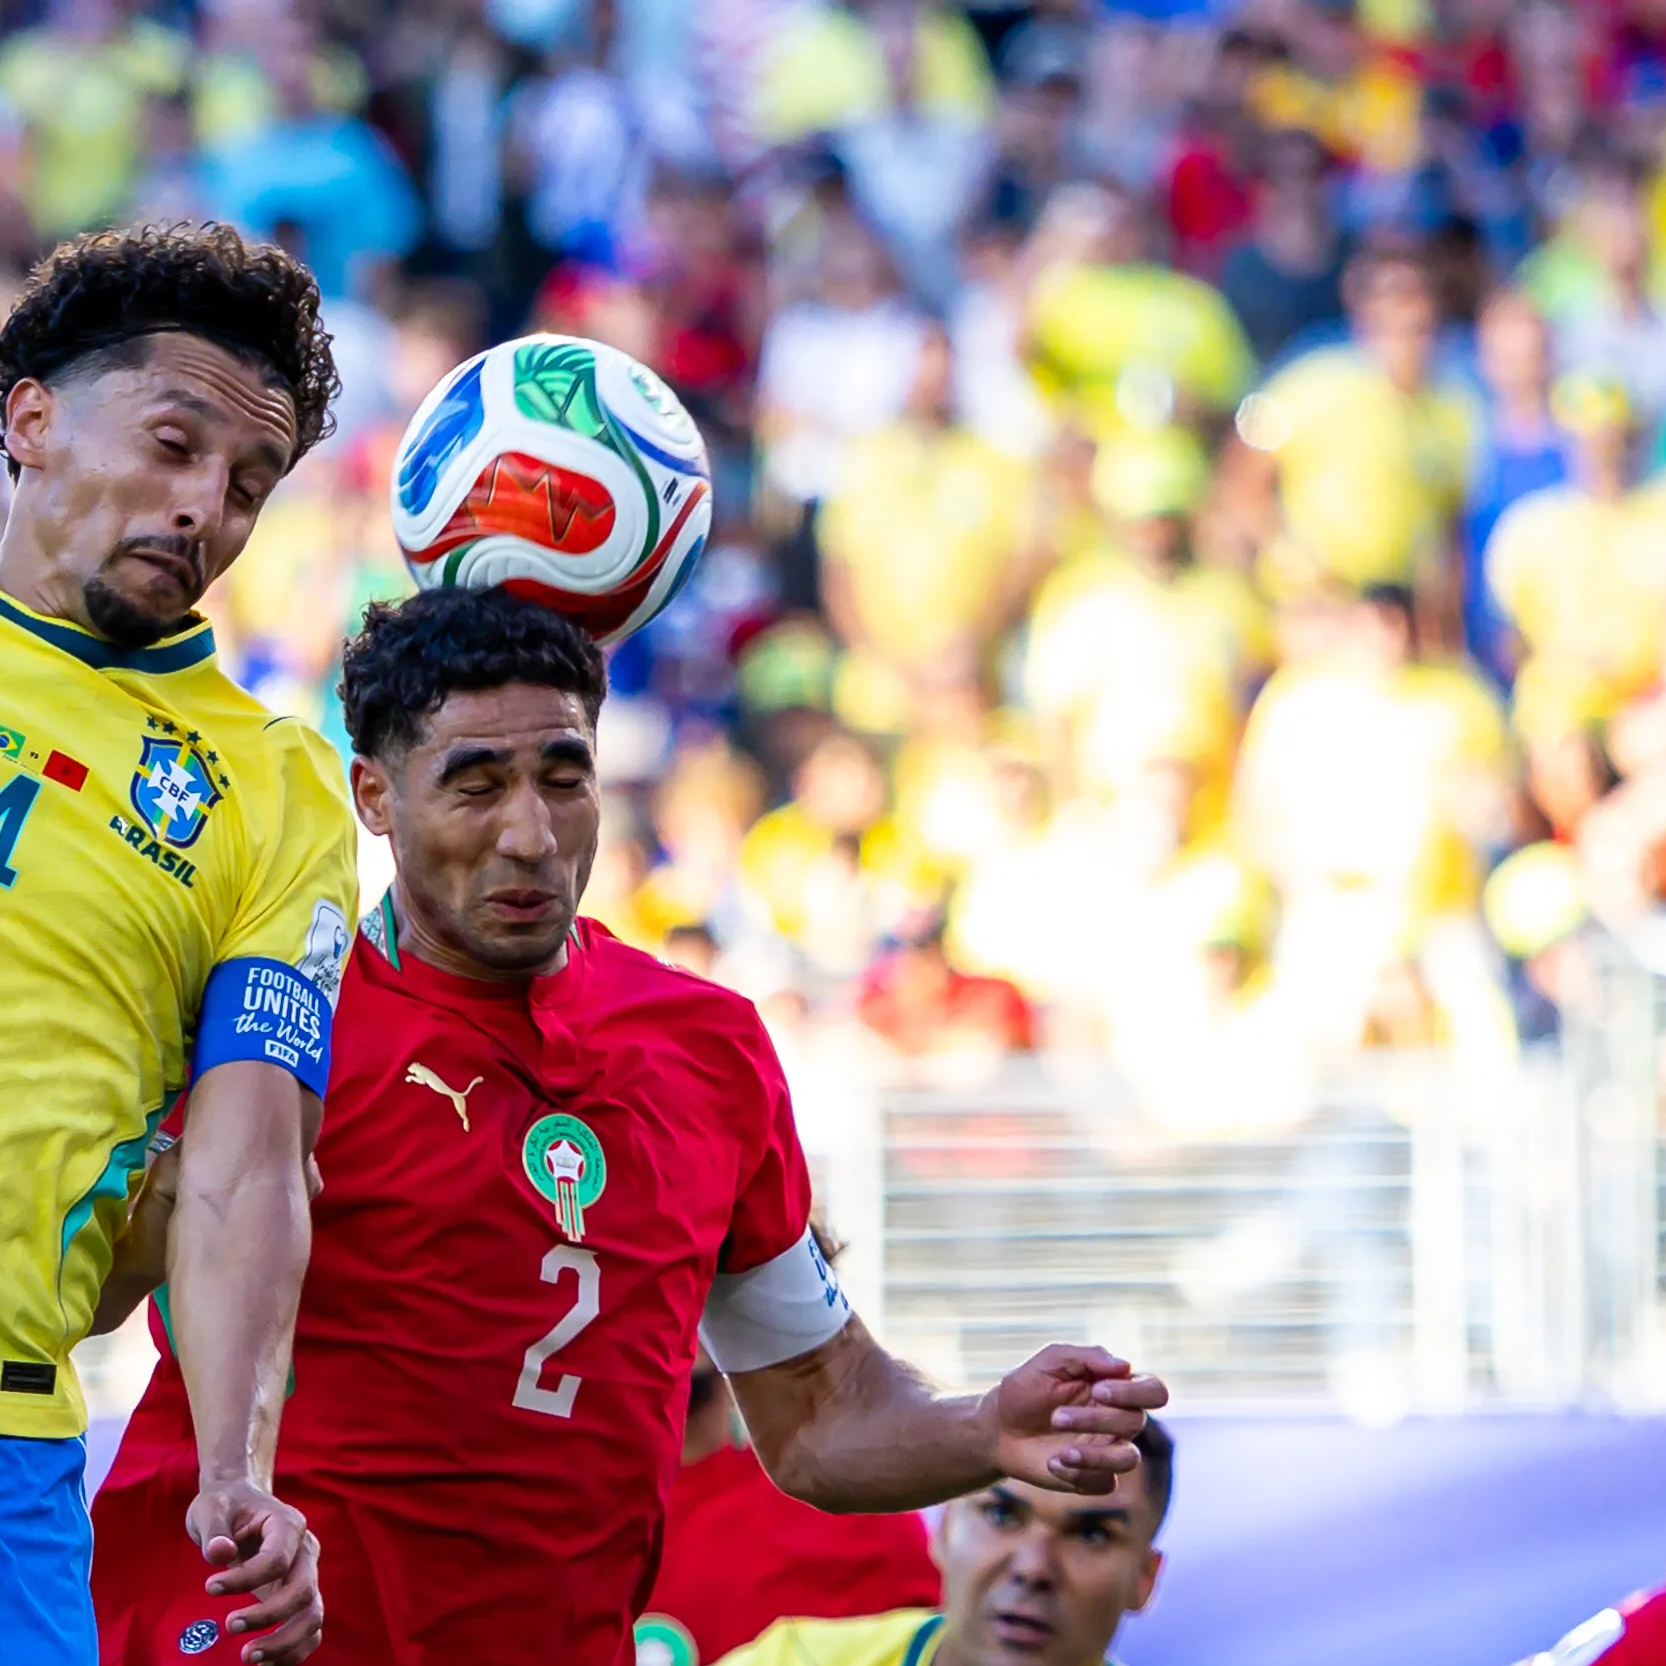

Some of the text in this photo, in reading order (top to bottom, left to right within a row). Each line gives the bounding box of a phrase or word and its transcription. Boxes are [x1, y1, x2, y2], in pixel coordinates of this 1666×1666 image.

[159, 776, 190, 803] CBF
[243, 986, 321, 1040] UNITES
[247, 967, 321, 1017] FOOTBALL
[233, 1012, 324, 1064] the World
[268, 1042, 297, 1065] FIFA
[510, 1242, 601, 1418] 2
